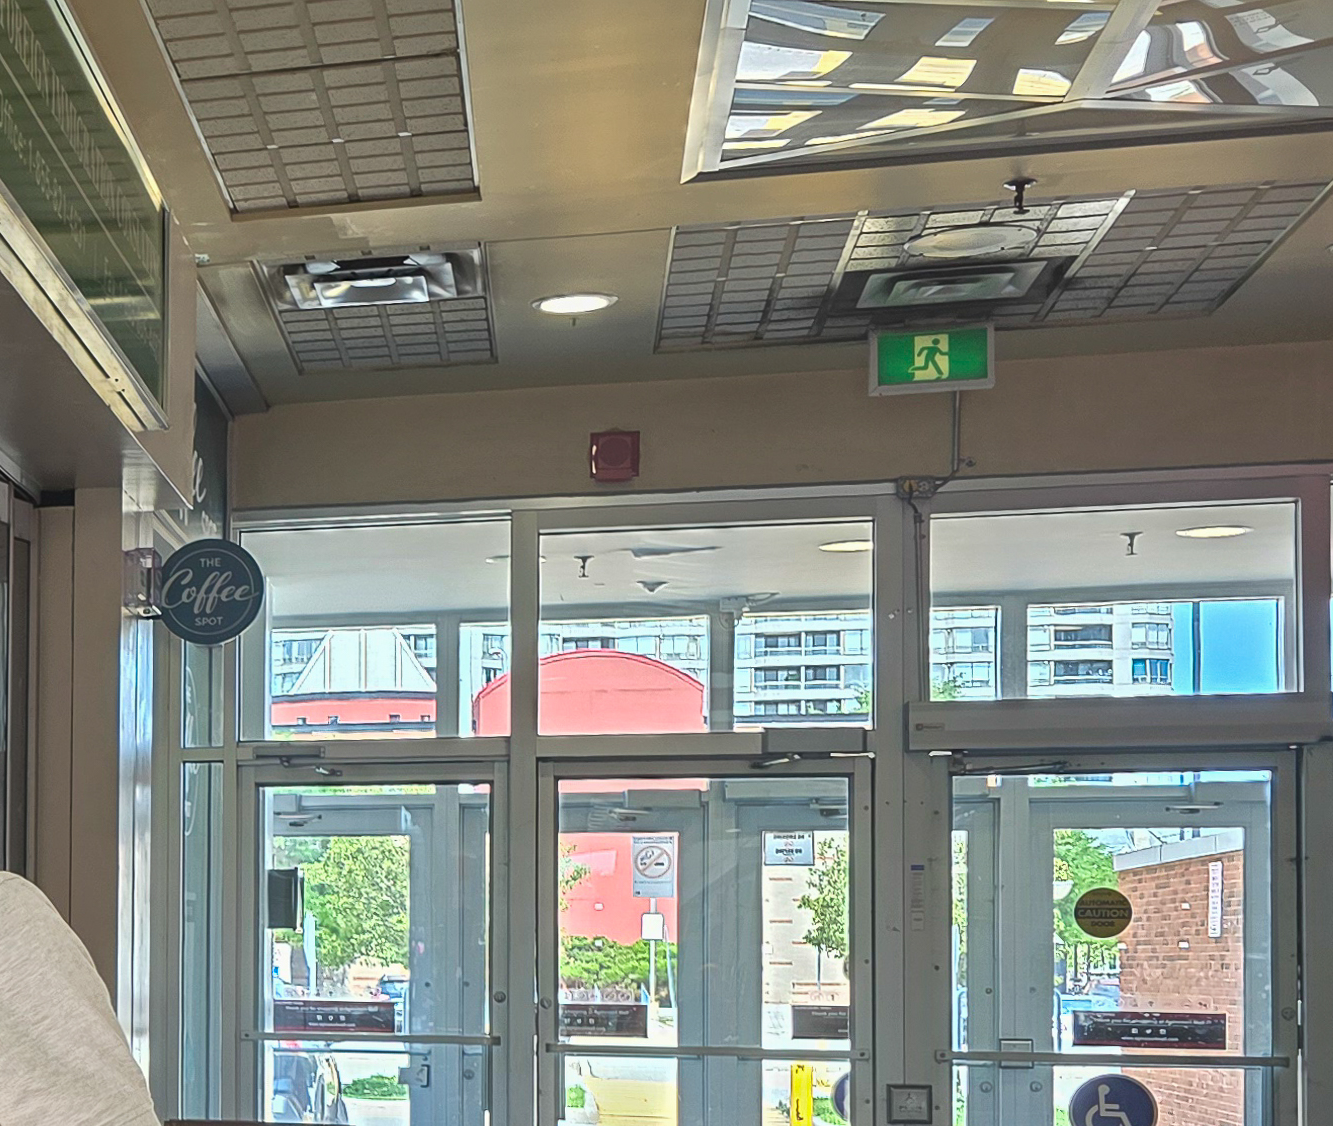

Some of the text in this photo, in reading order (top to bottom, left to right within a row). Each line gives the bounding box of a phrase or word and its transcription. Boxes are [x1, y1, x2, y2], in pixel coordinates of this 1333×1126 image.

[200, 557, 222, 568] THE
[162, 568, 259, 614] Coffee
[195, 616, 224, 627] SPOT
[1077, 908, 1129, 918] CAUTION
